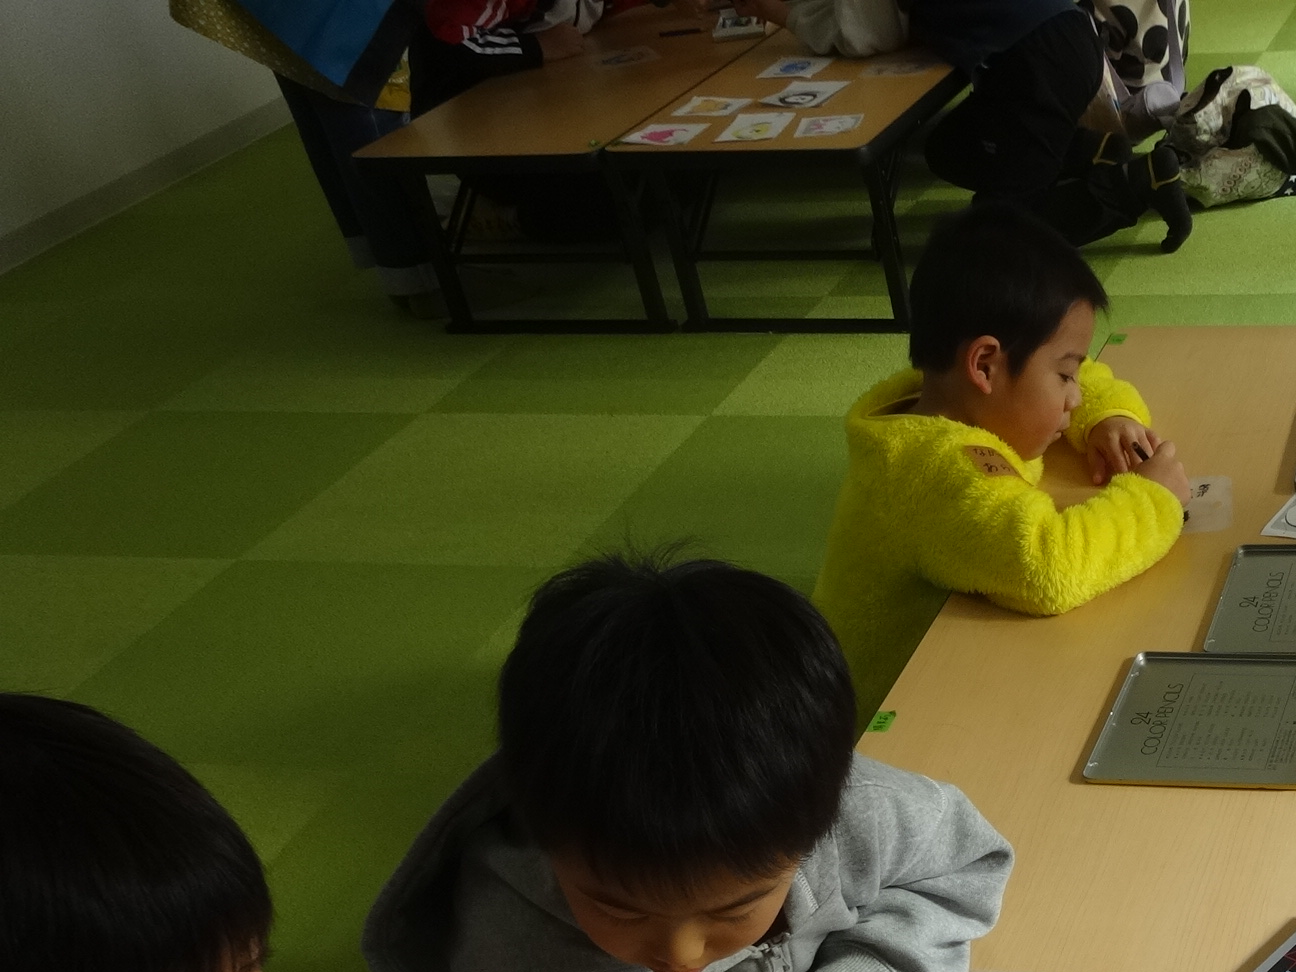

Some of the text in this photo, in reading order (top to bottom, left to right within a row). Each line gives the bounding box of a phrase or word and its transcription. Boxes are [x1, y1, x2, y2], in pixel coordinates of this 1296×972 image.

[1238, 596, 1259, 608] 24
[1252, 572, 1284, 632] COLOR PENCILS
[1130, 711, 1151, 726] 24
[1140, 682, 1184, 756] COLOR PENCILS
